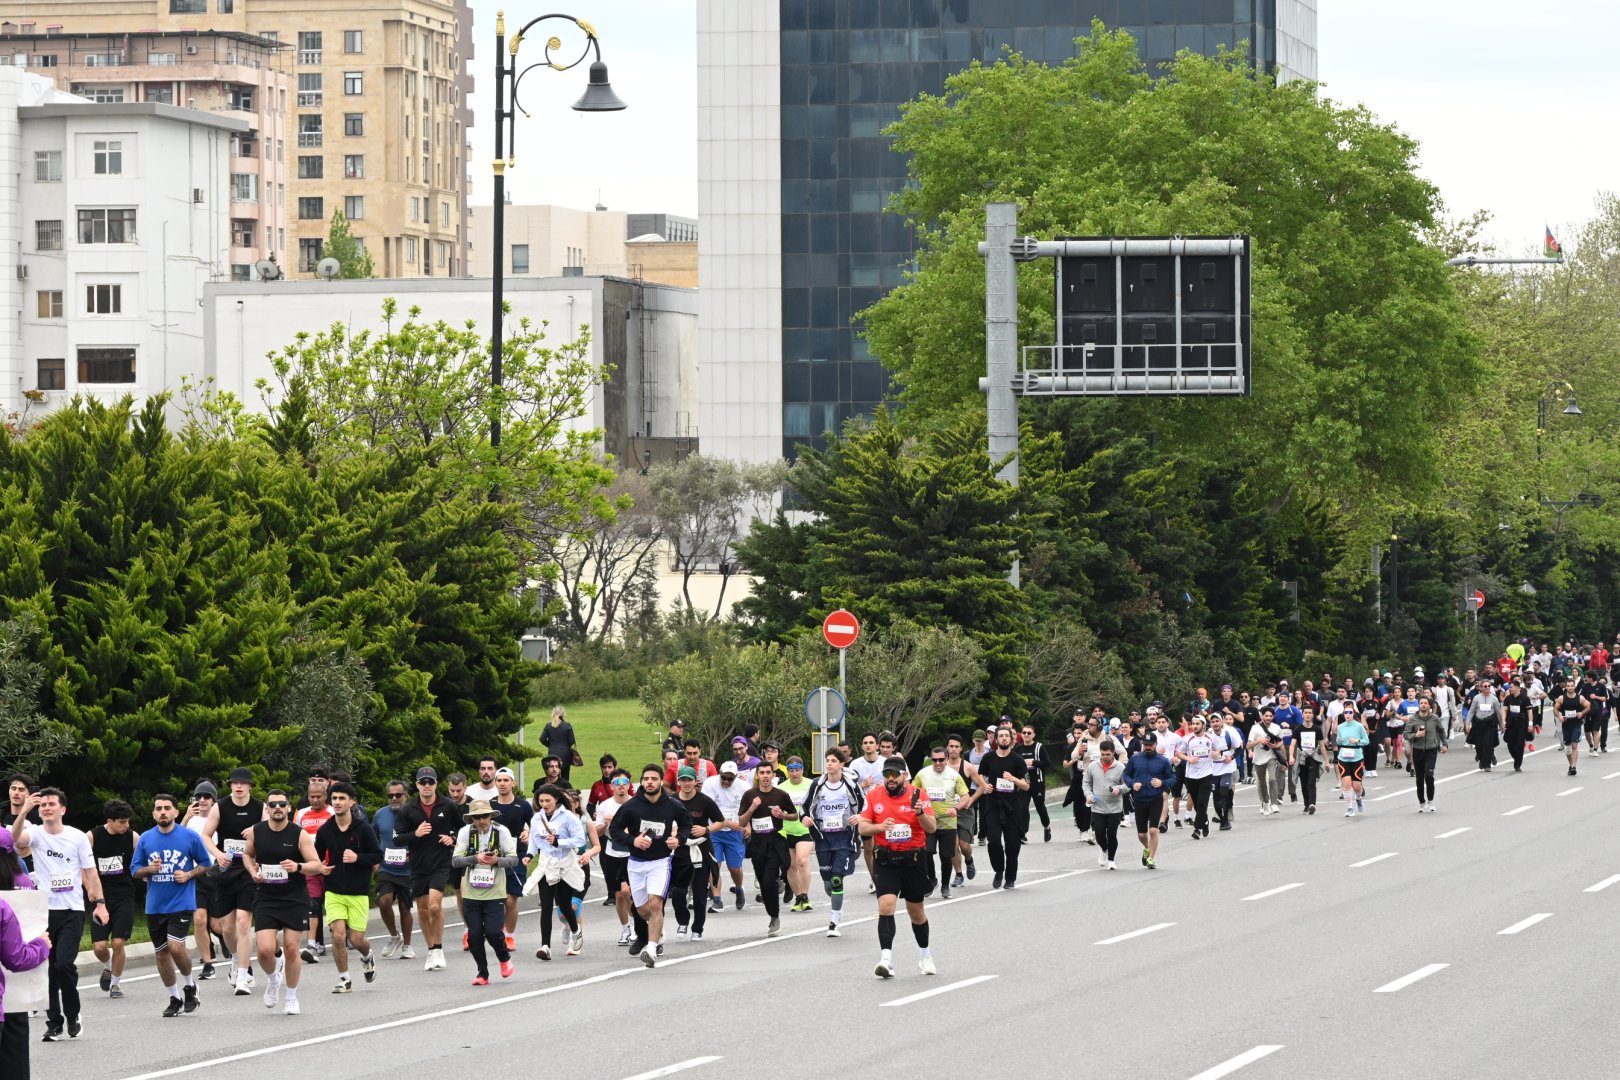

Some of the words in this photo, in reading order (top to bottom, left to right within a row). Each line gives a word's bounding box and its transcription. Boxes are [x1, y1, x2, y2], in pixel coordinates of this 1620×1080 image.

[887, 831, 911, 839] 24232
[266, 871, 283, 879] 7944
[472, 875, 490, 883] 4944
[51, 878, 73, 887] 10202
